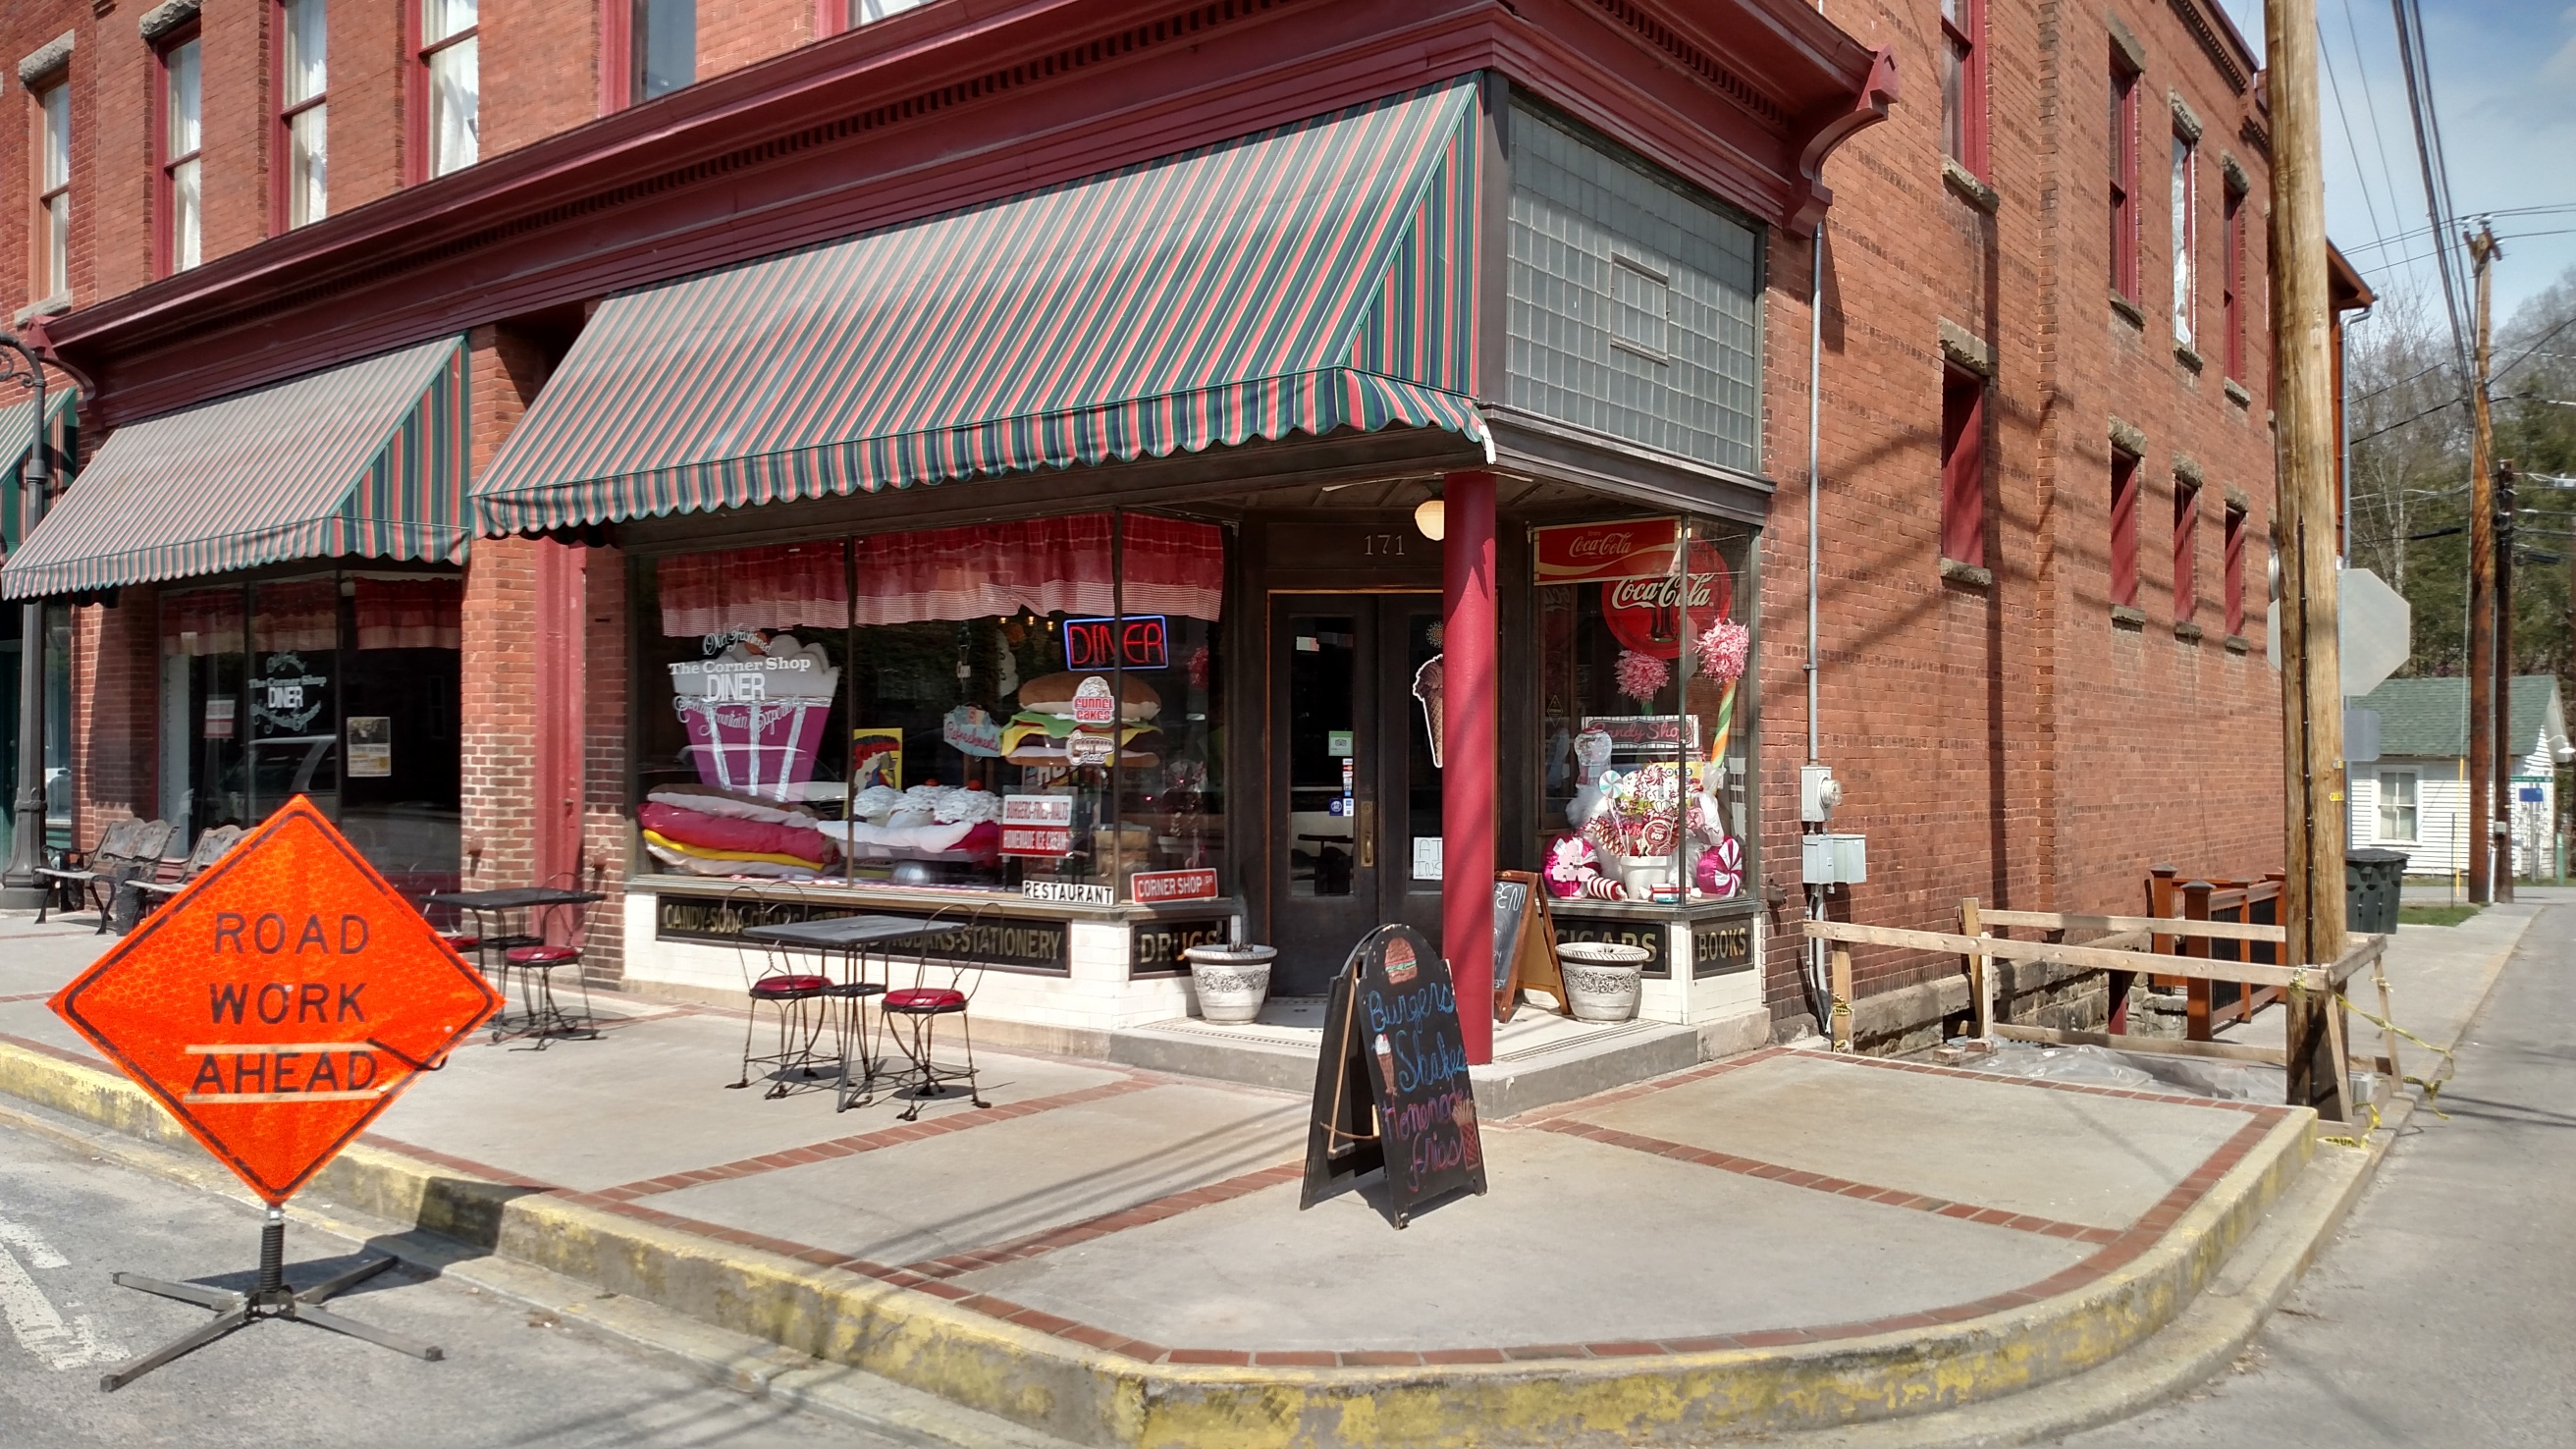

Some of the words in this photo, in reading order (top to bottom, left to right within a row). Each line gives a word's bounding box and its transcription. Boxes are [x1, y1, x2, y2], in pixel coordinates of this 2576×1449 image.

[1364, 534, 1406, 556] 171
[1569, 531, 1635, 558] Coca-Cola
[1611, 572, 1714, 610] Coca-Cla
[702, 625, 728, 656] Old
[1067, 623, 1165, 665] DINER
[668, 663, 700, 675] The
[702, 660, 764, 673] Corner
[766, 657, 811, 671] Shop
[268, 686, 303, 708] DINER
[707, 672, 766, 702] DINER
[1003, 830, 1036, 849] HOMEMADE
[1036, 831, 1046, 850] ICE
[1046, 831, 1067, 850] CREAM
[1024, 882, 1113, 904] RESTAURANT
[1138, 878, 1176, 897] CORNER
[1177, 876, 1203, 894] SHOP
[1205, 875, 1213, 884] DR
[213, 912, 369, 954] ROAD
[1698, 927, 1747, 962] BOOKS
[209, 983, 367, 1025] WORK
[1368, 982, 1456, 1032] Burgers
[188, 1050, 378, 1095] AHEAD
[1394, 1030, 1470, 1093] Shakes
